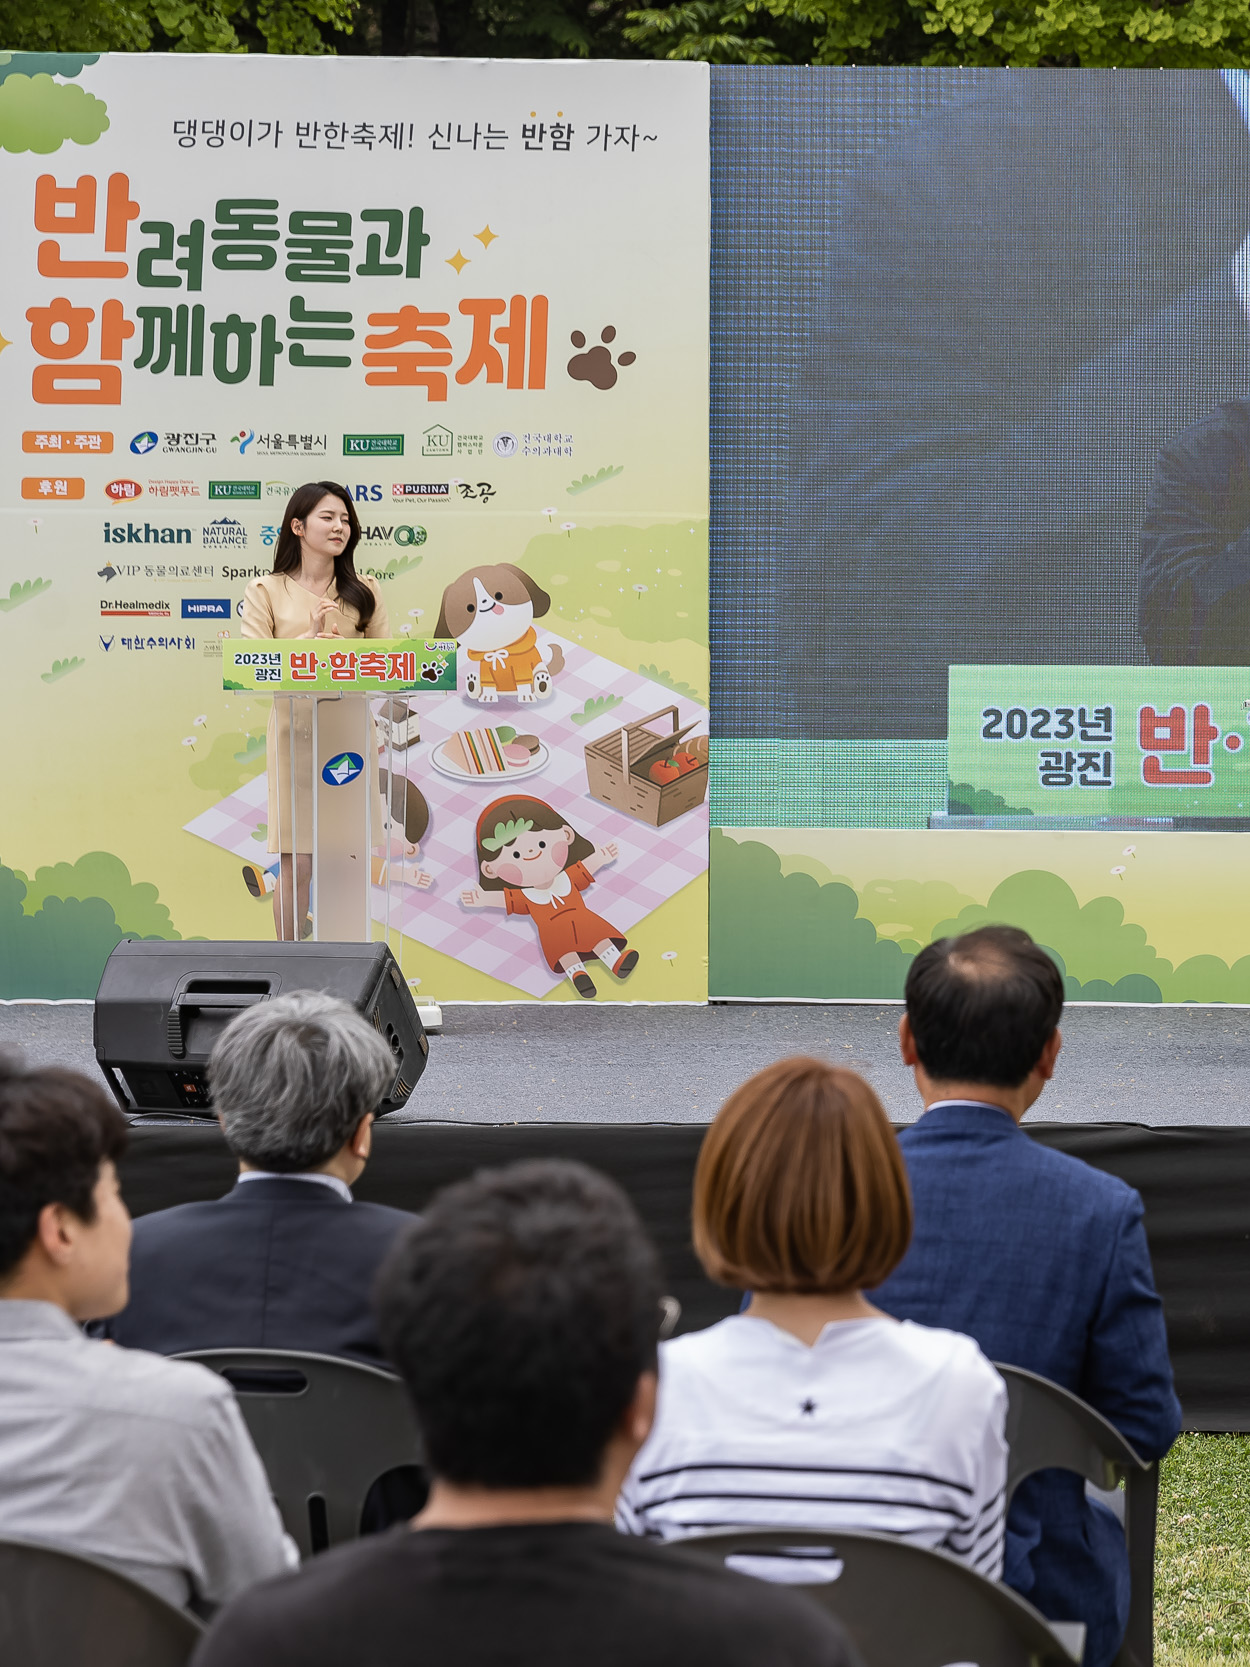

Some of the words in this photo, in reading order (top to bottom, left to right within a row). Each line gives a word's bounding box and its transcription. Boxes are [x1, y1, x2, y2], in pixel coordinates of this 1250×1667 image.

[172, 118, 284, 150] 댕댕이가
[295, 121, 414, 151] 반한축제!
[427, 122, 509, 151] 신나는
[521, 122, 575, 152] 반함
[586, 123, 658, 153] 가자~
[34, 172, 431, 292] 반려동물과
[26, 296, 355, 406] 함께하는
[361, 294, 549, 402] 축제
[164, 432, 217, 446] 광진구
[257, 433, 327, 450] 서울특별시
[350, 439, 370, 451] KU
[427, 435, 450, 447] KU
[38, 480, 68, 496] 후원
[110, 482, 136, 498] 하림
[149, 485, 200, 497] 하림펫푸드
[214, 485, 231, 495] KU
[458, 482, 496, 504] 조공
[104, 522, 193, 544] iskhan
[203, 526, 248, 536] NATURAL
[203, 536, 248, 545] BALANCE
[116, 565, 141, 577] VIP
[144, 564, 214, 577] 동물의료센터
[187, 604, 224, 613] HIPRA
[121, 635, 195, 650] 대한수의사회
[234, 653, 281, 666] 2023년
[255, 668, 282, 681] 광진
[982, 707, 1112, 742] 2023년
[1038, 751, 1112, 786] 광진
